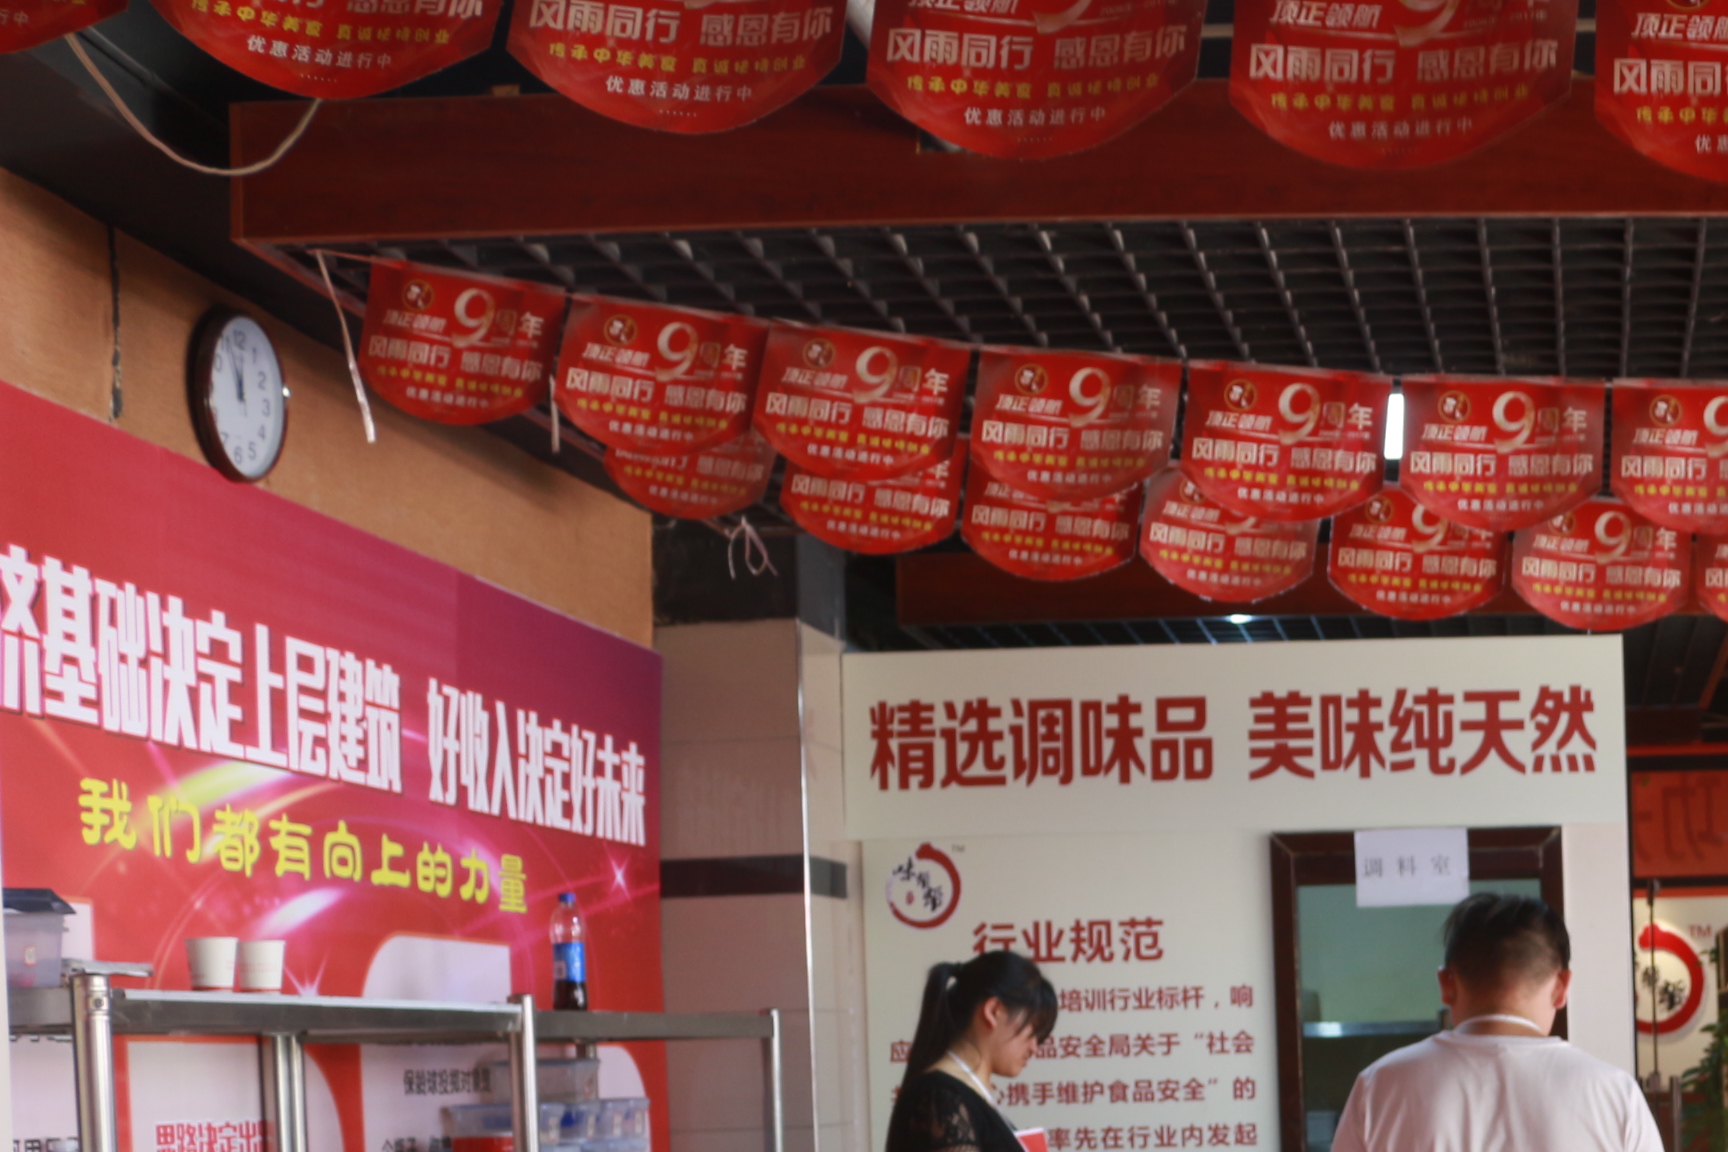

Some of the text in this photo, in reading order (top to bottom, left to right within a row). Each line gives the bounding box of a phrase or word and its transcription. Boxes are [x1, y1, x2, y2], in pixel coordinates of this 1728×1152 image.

[700, 8, 833, 46] 感恩有你
[247, 34, 392, 70] 优惠活动进行中
[886, 24, 1187, 70] 风雨同行 感恩有你
[1248, 40, 1560, 82] 风雨同行 感恩有你
[605, 75, 752, 102] 优惠活动进行中
[964, 105, 1106, 127] 优惠活动进行中
[1328, 118, 1473, 140] 优惠活动进行中
[369, 336, 543, 383] 风雨同行 感恩有你
[567, 367, 746, 413] 风雨同行 感恩有你
[766, 393, 949, 438] 风雨同行 感恩有你
[981, 421, 1163, 452] 风雨同行 感恩有你
[1193, 438, 1377, 473] 风雨同行 感恩有你
[1410, 452, 1594, 476] 风雨同行 感恩有你
[1620, 455, 1707, 480] 风雨同行
[870, 685, 1597, 790] 精选调味品 美味纯天然
[428, 678, 646, 847] 好收入决定好未来
[79, 777, 527, 913] 我们都有向上的力量
[973, 918, 1164, 963] 行业规范
[996, 1077, 1255, 1106] 携手维护食品安全”的
